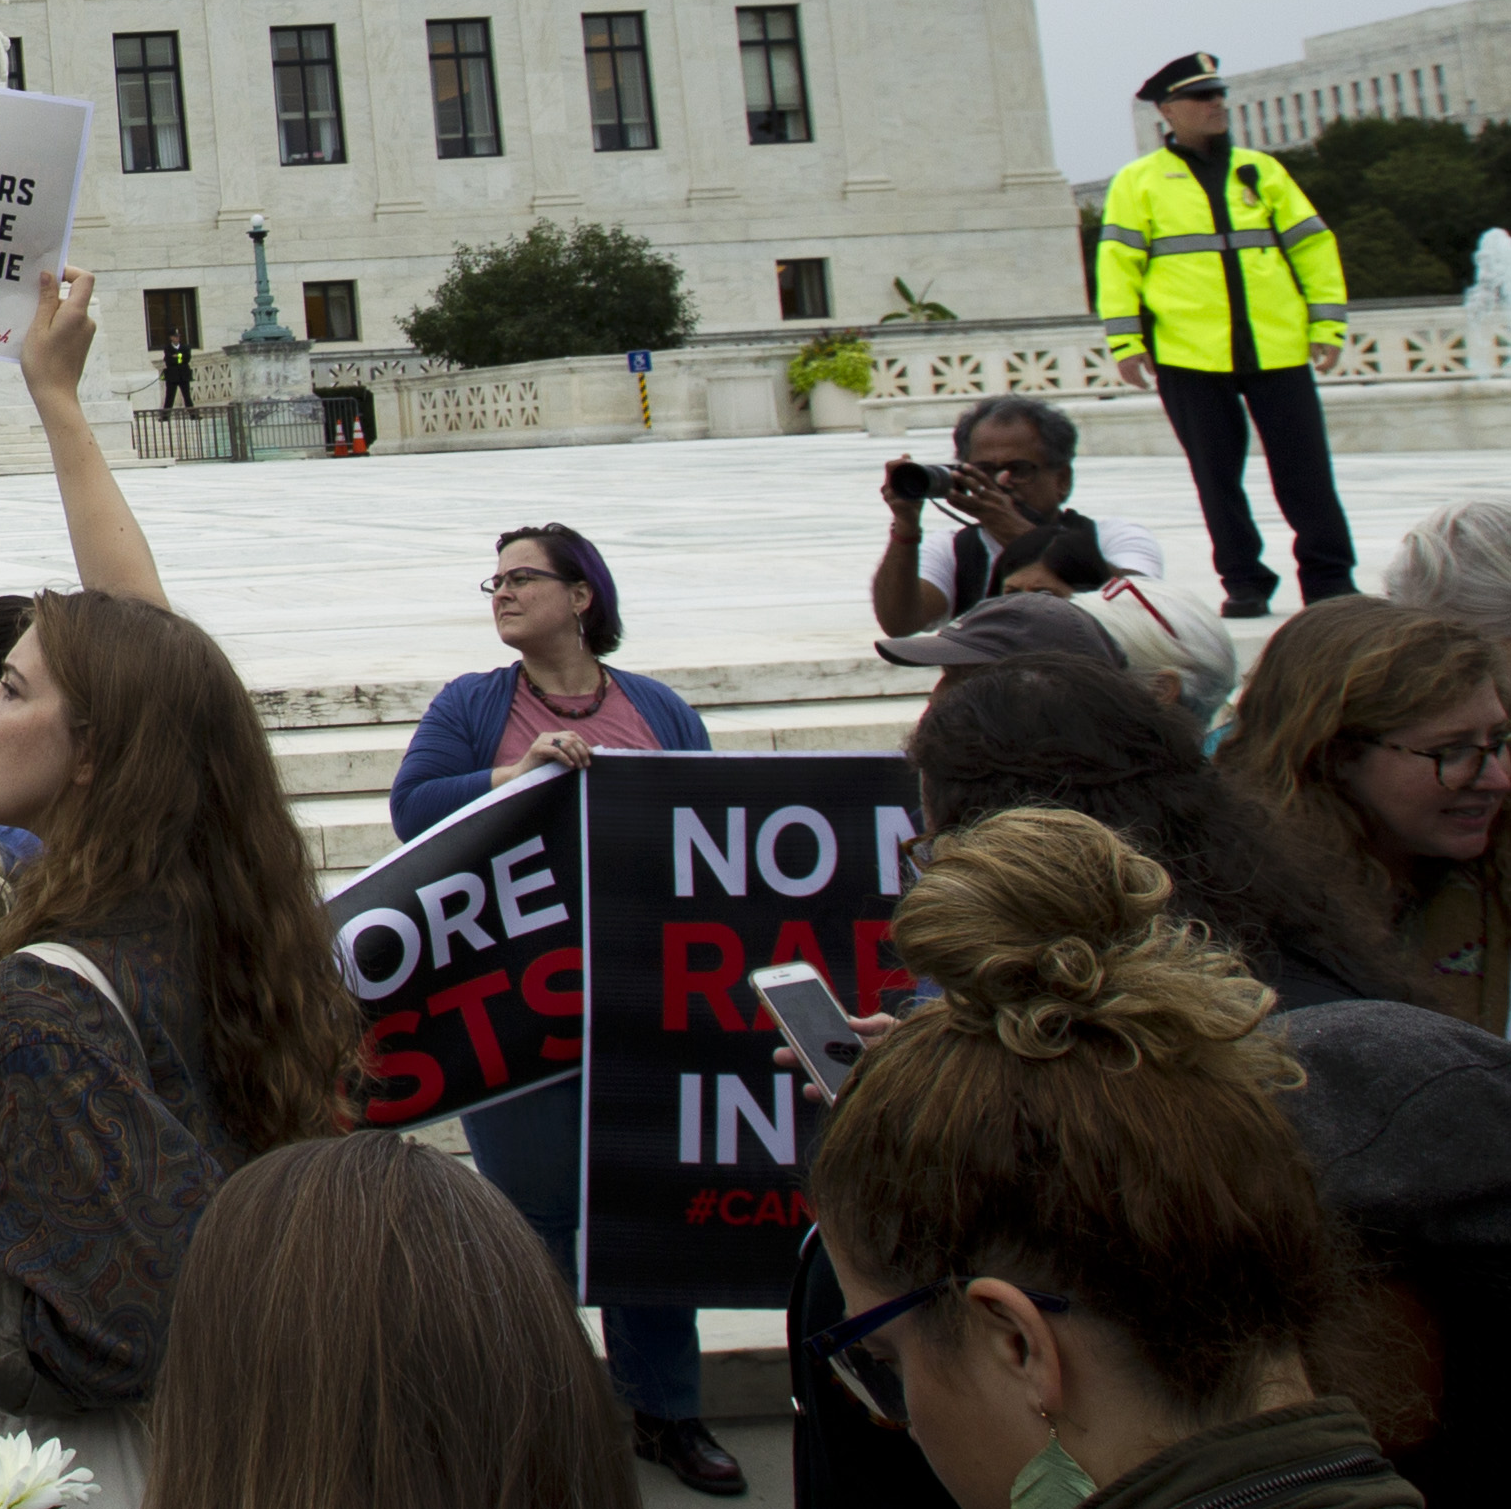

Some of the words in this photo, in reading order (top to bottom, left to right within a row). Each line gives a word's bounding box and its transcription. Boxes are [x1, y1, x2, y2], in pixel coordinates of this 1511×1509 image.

[673, 805, 837, 897] NO
[332, 835, 570, 1001] ORE
[662, 919, 919, 1032] RAP
[334, 947, 584, 1134] STS
[679, 1073, 797, 1165] IN
[685, 1189, 819, 1227] #CAN
